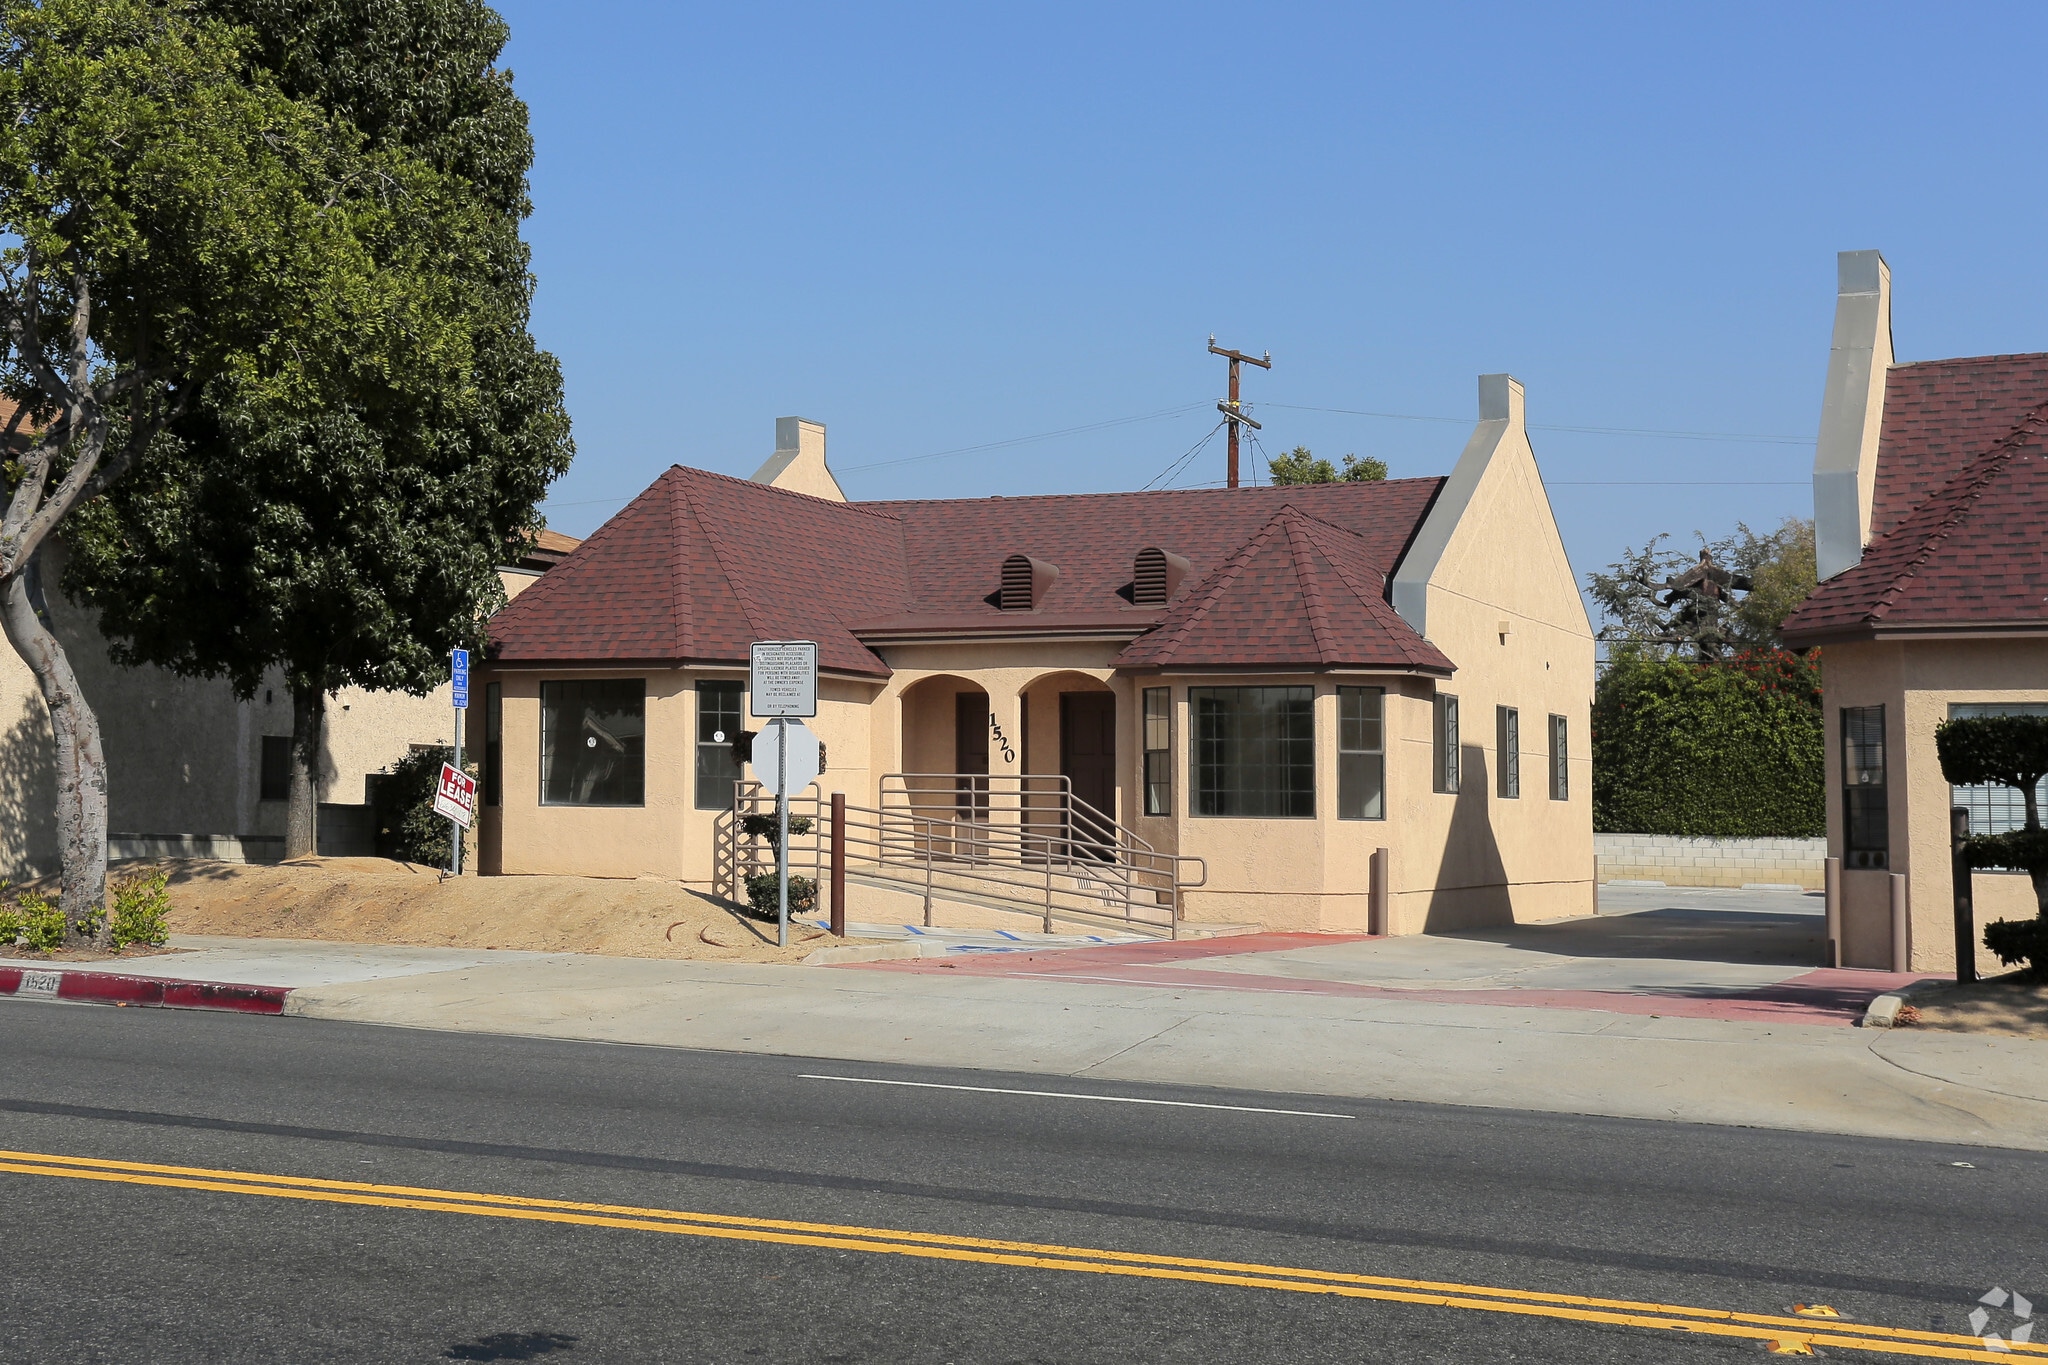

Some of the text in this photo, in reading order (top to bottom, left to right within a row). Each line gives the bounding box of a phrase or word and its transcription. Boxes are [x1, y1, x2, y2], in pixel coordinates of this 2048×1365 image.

[990, 712, 1015, 763] 1520
[440, 779, 472, 809] LEASE
[451, 772, 466, 788] FOR
